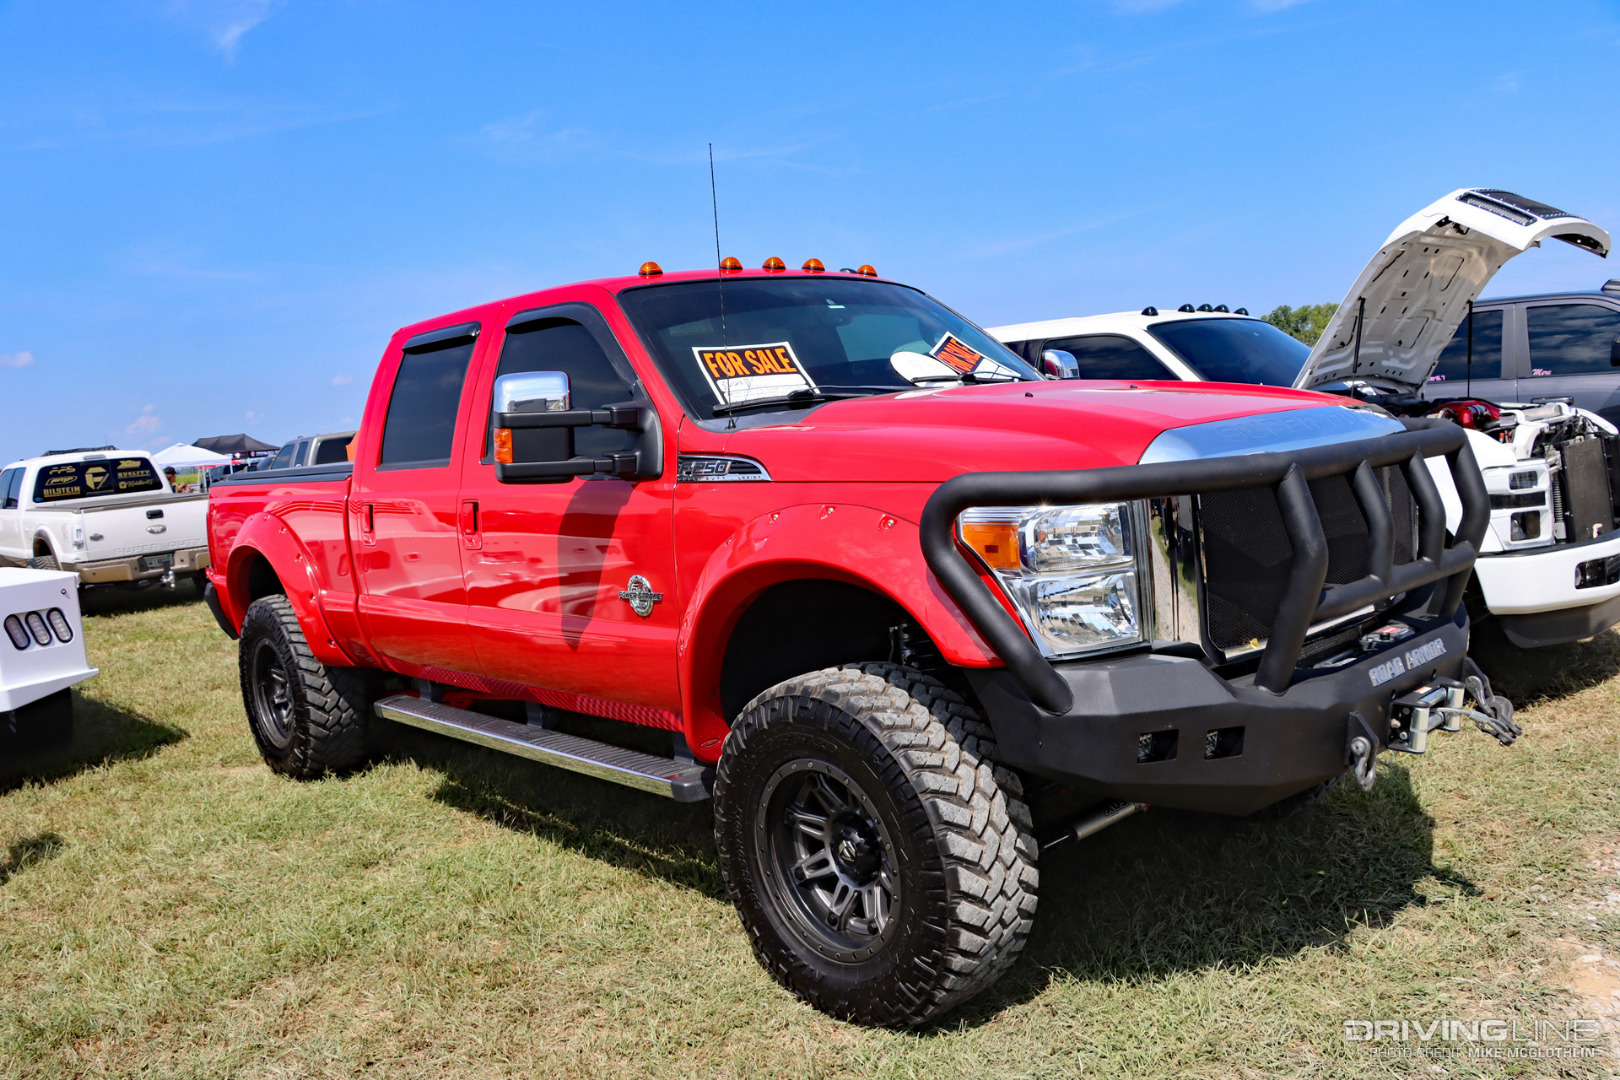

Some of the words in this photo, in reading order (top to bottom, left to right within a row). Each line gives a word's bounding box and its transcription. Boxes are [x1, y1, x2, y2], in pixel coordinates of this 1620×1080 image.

[702, 351, 751, 378] FOR
[744, 347, 798, 375] SALE
[43, 486, 81, 497] BILSTEIN
[112, 543, 160, 556] SUPER
[168, 537, 203, 548] DUTY
[1368, 656, 1406, 688] ROAD
[1405, 637, 1448, 671] ARMOR
